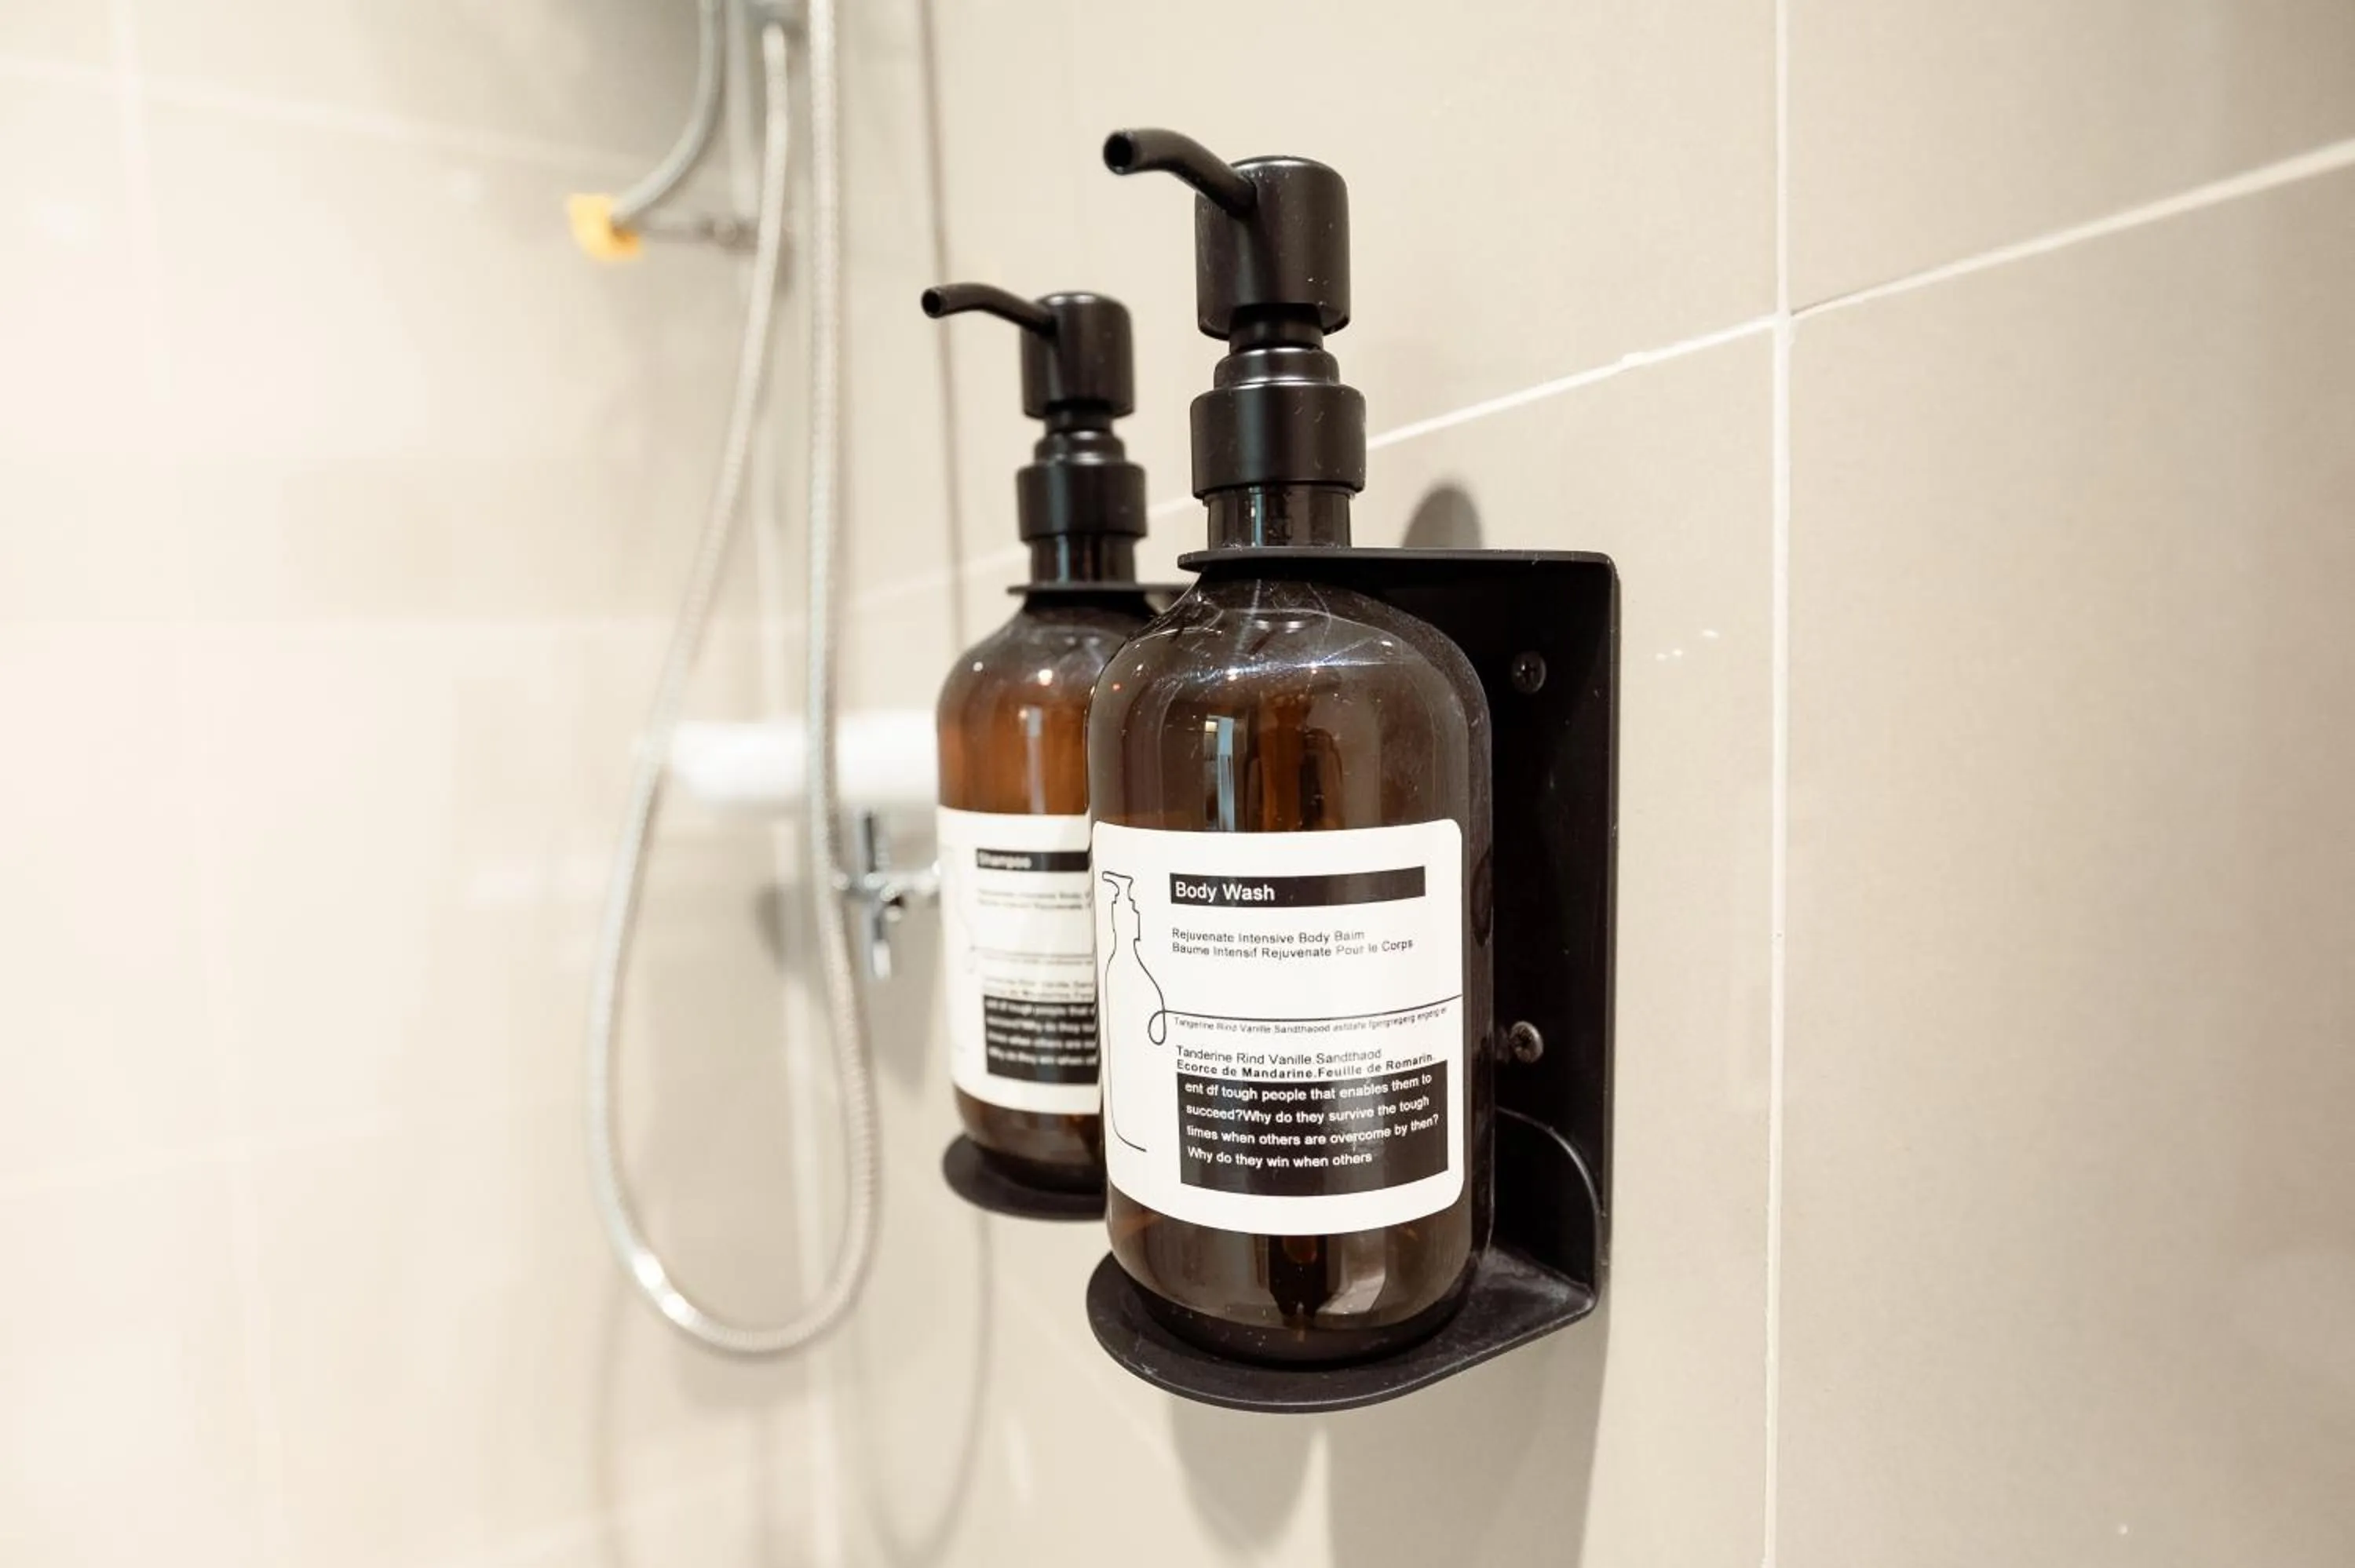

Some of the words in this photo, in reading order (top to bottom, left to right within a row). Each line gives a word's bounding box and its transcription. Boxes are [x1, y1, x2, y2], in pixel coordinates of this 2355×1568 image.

[1175, 881, 1216, 903] Body
[1222, 883, 1275, 901] Wash
[1172, 928, 1234, 943] Rejuvenate
[1239, 932, 1294, 943] Intensive
[1299, 932, 1330, 944] Body
[1172, 942, 1210, 955] Baume
[1214, 946, 1257, 958] Intensif
[1261, 947, 1332, 961] Rejuvenate
[1336, 944, 1364, 955] Pour
[1368, 943, 1378, 953] le
[1382, 939, 1413, 952] Corps
[1178, 1059, 1218, 1074] Ecorce
[1222, 1067, 1237, 1077] de
[1367, 1063, 1382, 1073] de
[1236, 1052, 1264, 1065] Rind
[1185, 1083, 1203, 1095] ent
[1221, 1086, 1258, 1101] tough
[1261, 1088, 1306, 1103] people
[1310, 1088, 1335, 1099] that
[1339, 1082, 1389, 1098] enables
[1392, 1078, 1419, 1092] them
[1422, 1074, 1432, 1085] to
[1276, 1111, 1293, 1123] do
[1297, 1111, 1324, 1125] they
[1329, 1107, 1374, 1121] survive
[1378, 1104, 1397, 1116] the
[1399, 1096, 1429, 1112] tough
[1186, 1125, 1218, 1140] times
[1221, 1131, 1255, 1143] when
[1258, 1133, 1301, 1146] others
[1304, 1136, 1327, 1146] are
[1330, 1127, 1392, 1143] overcome
[1394, 1124, 1408, 1137] by
[1188, 1146, 1213, 1163] Why
[1217, 1151, 1232, 1164] do
[1235, 1154, 1263, 1169] they
[1266, 1158, 1290, 1168] win
[1293, 1156, 1329, 1168] when
[1332, 1153, 1372, 1166] others
